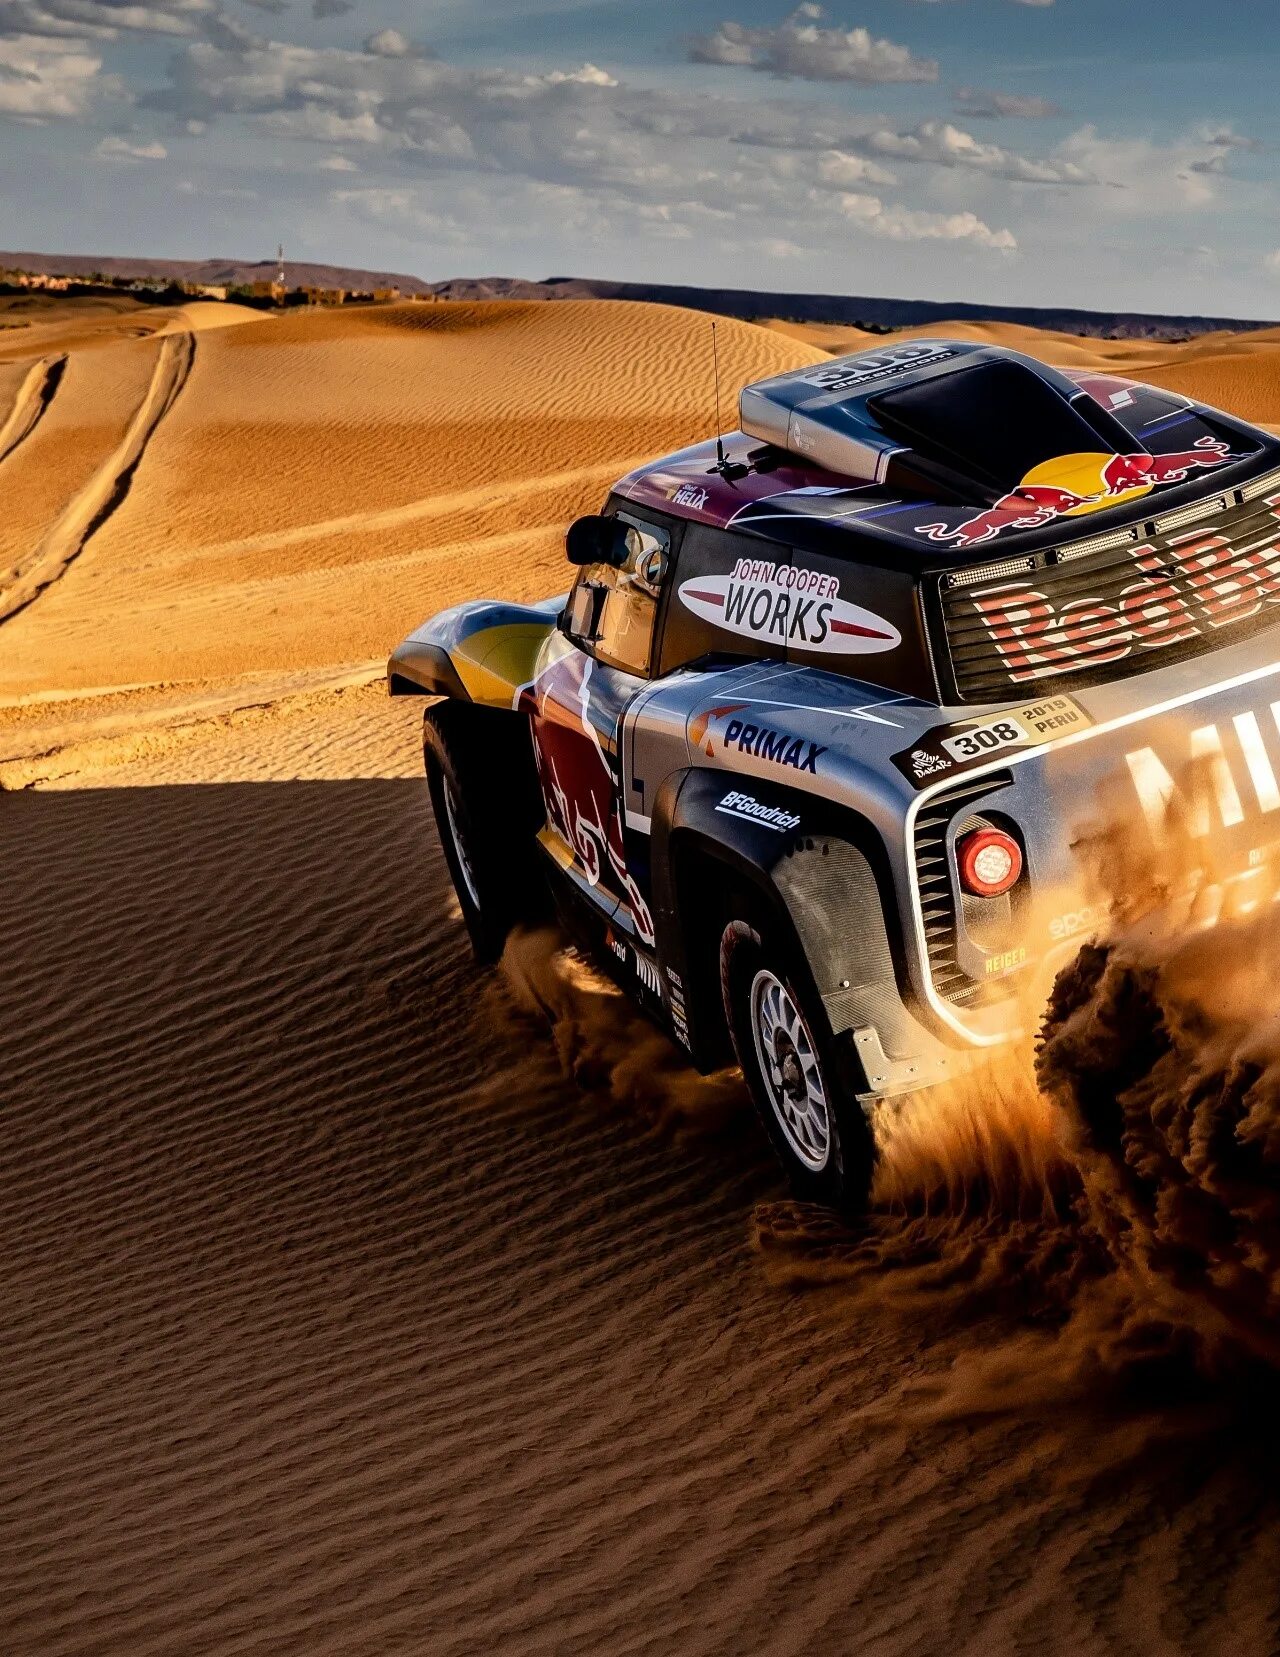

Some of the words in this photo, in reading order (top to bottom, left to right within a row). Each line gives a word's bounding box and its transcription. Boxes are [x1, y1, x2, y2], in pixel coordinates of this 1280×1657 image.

[805, 345, 934, 383] 308
[831, 351, 952, 390] dakar.com
[672, 487, 709, 510] HELIX
[730, 558, 774, 584] JOHN
[775, 566, 839, 599] COOPER
[724, 583, 834, 644] WORKS
[970, 544, 1201, 683] Red
[1022, 698, 1067, 720] 2019
[1034, 710, 1080, 733] PERU
[723, 719, 829, 775] PRIMAX
[954, 723, 1019, 756] 308
[913, 760, 948, 779] DAKAR
[719, 790, 801, 829] BFGoodrich
